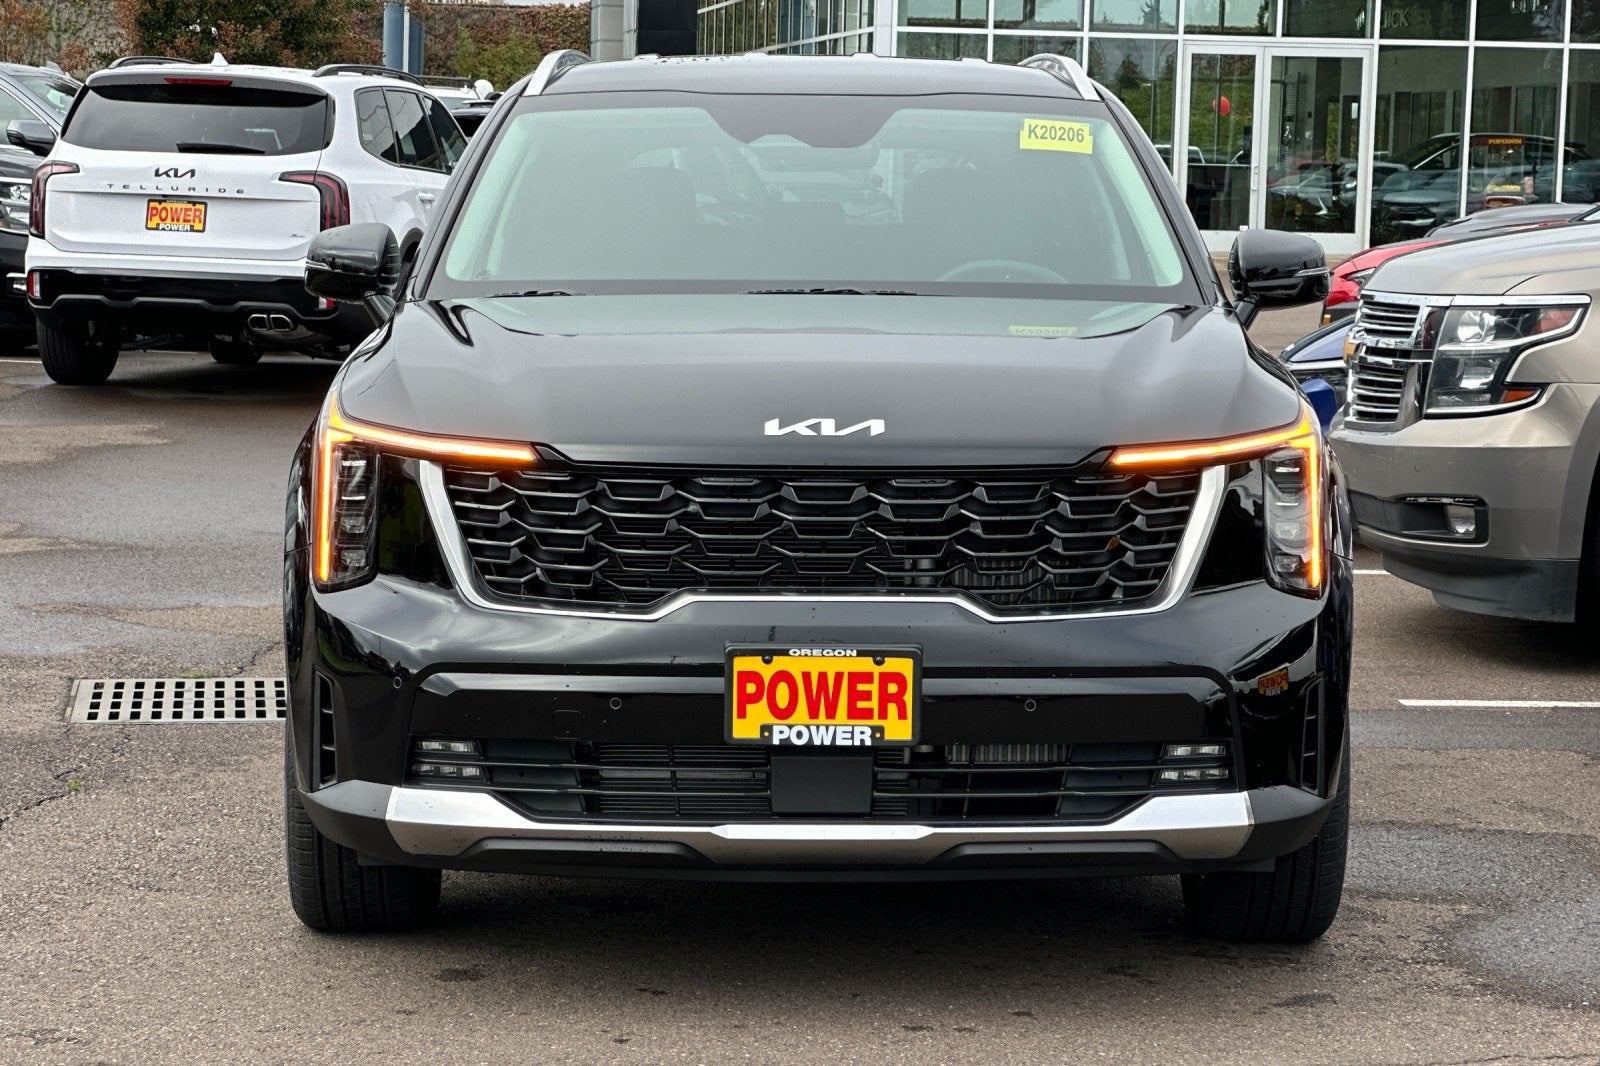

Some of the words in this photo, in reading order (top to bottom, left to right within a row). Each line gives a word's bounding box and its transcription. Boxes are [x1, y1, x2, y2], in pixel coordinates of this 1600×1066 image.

[1028, 124, 1085, 143] K20206
[154, 167, 196, 179] KIA
[107, 183, 245, 194] TELLURIDE
[149, 206, 203, 224] POWER
[159, 223, 191, 232] POWER
[764, 418, 886, 437] KIA
[788, 648, 858, 657] OREGON
[736, 670, 908, 720] POWER
[772, 725, 873, 746] POWER
